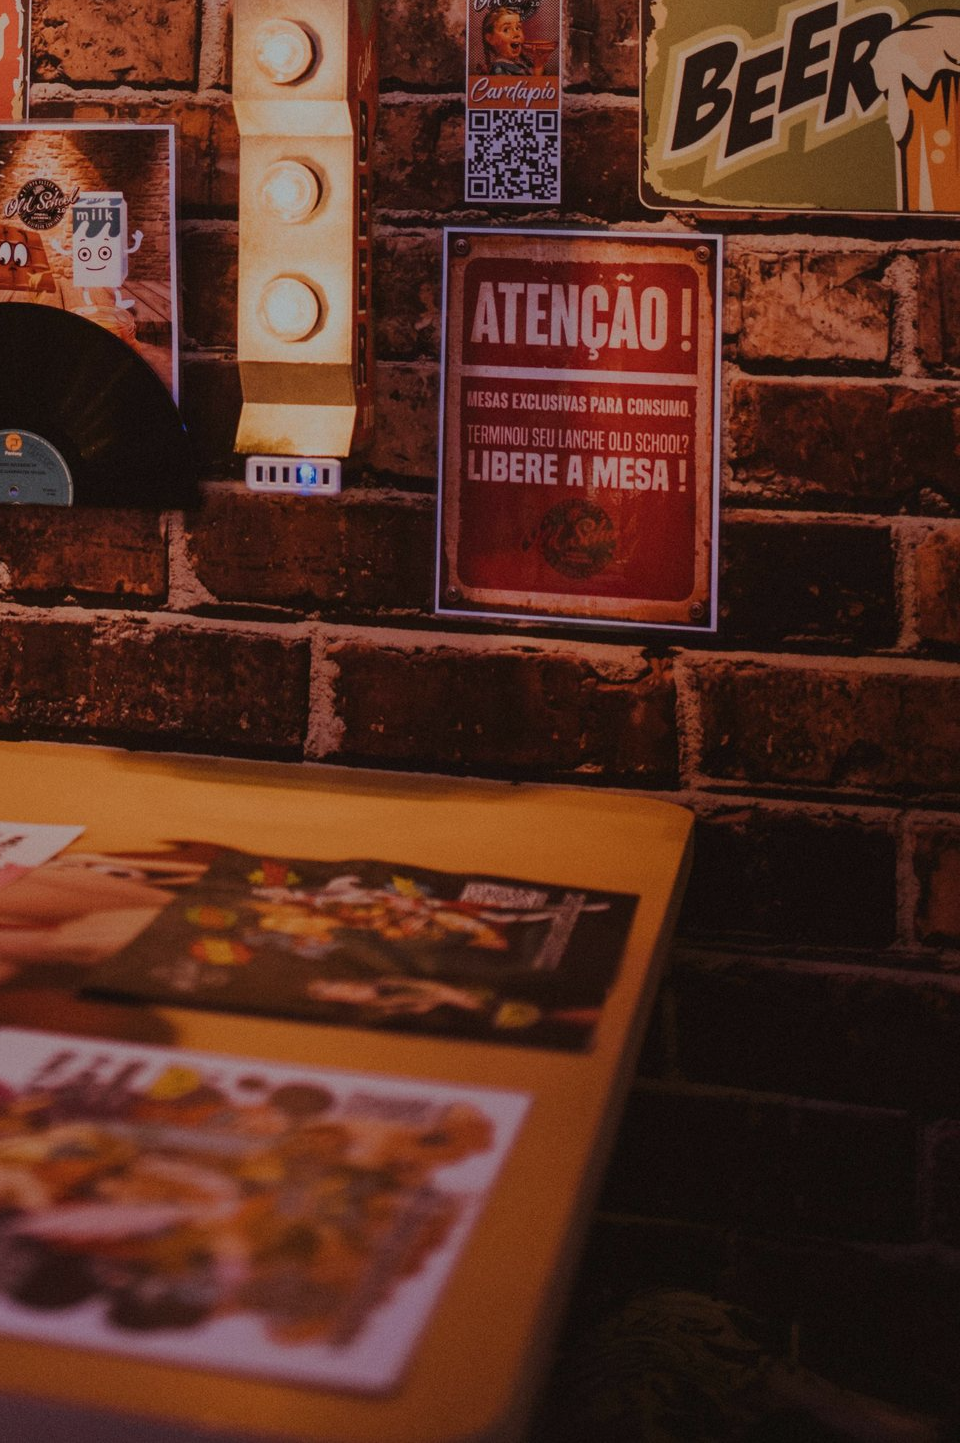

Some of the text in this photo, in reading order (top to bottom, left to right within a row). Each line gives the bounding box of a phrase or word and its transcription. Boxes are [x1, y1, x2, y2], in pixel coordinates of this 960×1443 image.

[471, 77, 556, 108] Cardápio
[671, 1, 893, 159] BEER
[4, 186, 81, 218] Old School
[76, 208, 114, 221] milk
[471, 273, 669, 361] ATENÇÃO
[467, 390, 692, 418] MESAS EXCLUSIVAS PARA CONSUMO.
[467, 424, 689, 455] TERMINOU SEU LANCHE OLD SCHOOL?
[467, 448, 558, 485] LIBERE
[566, 454, 584, 487] A
[592, 456, 669, 492] MESA
